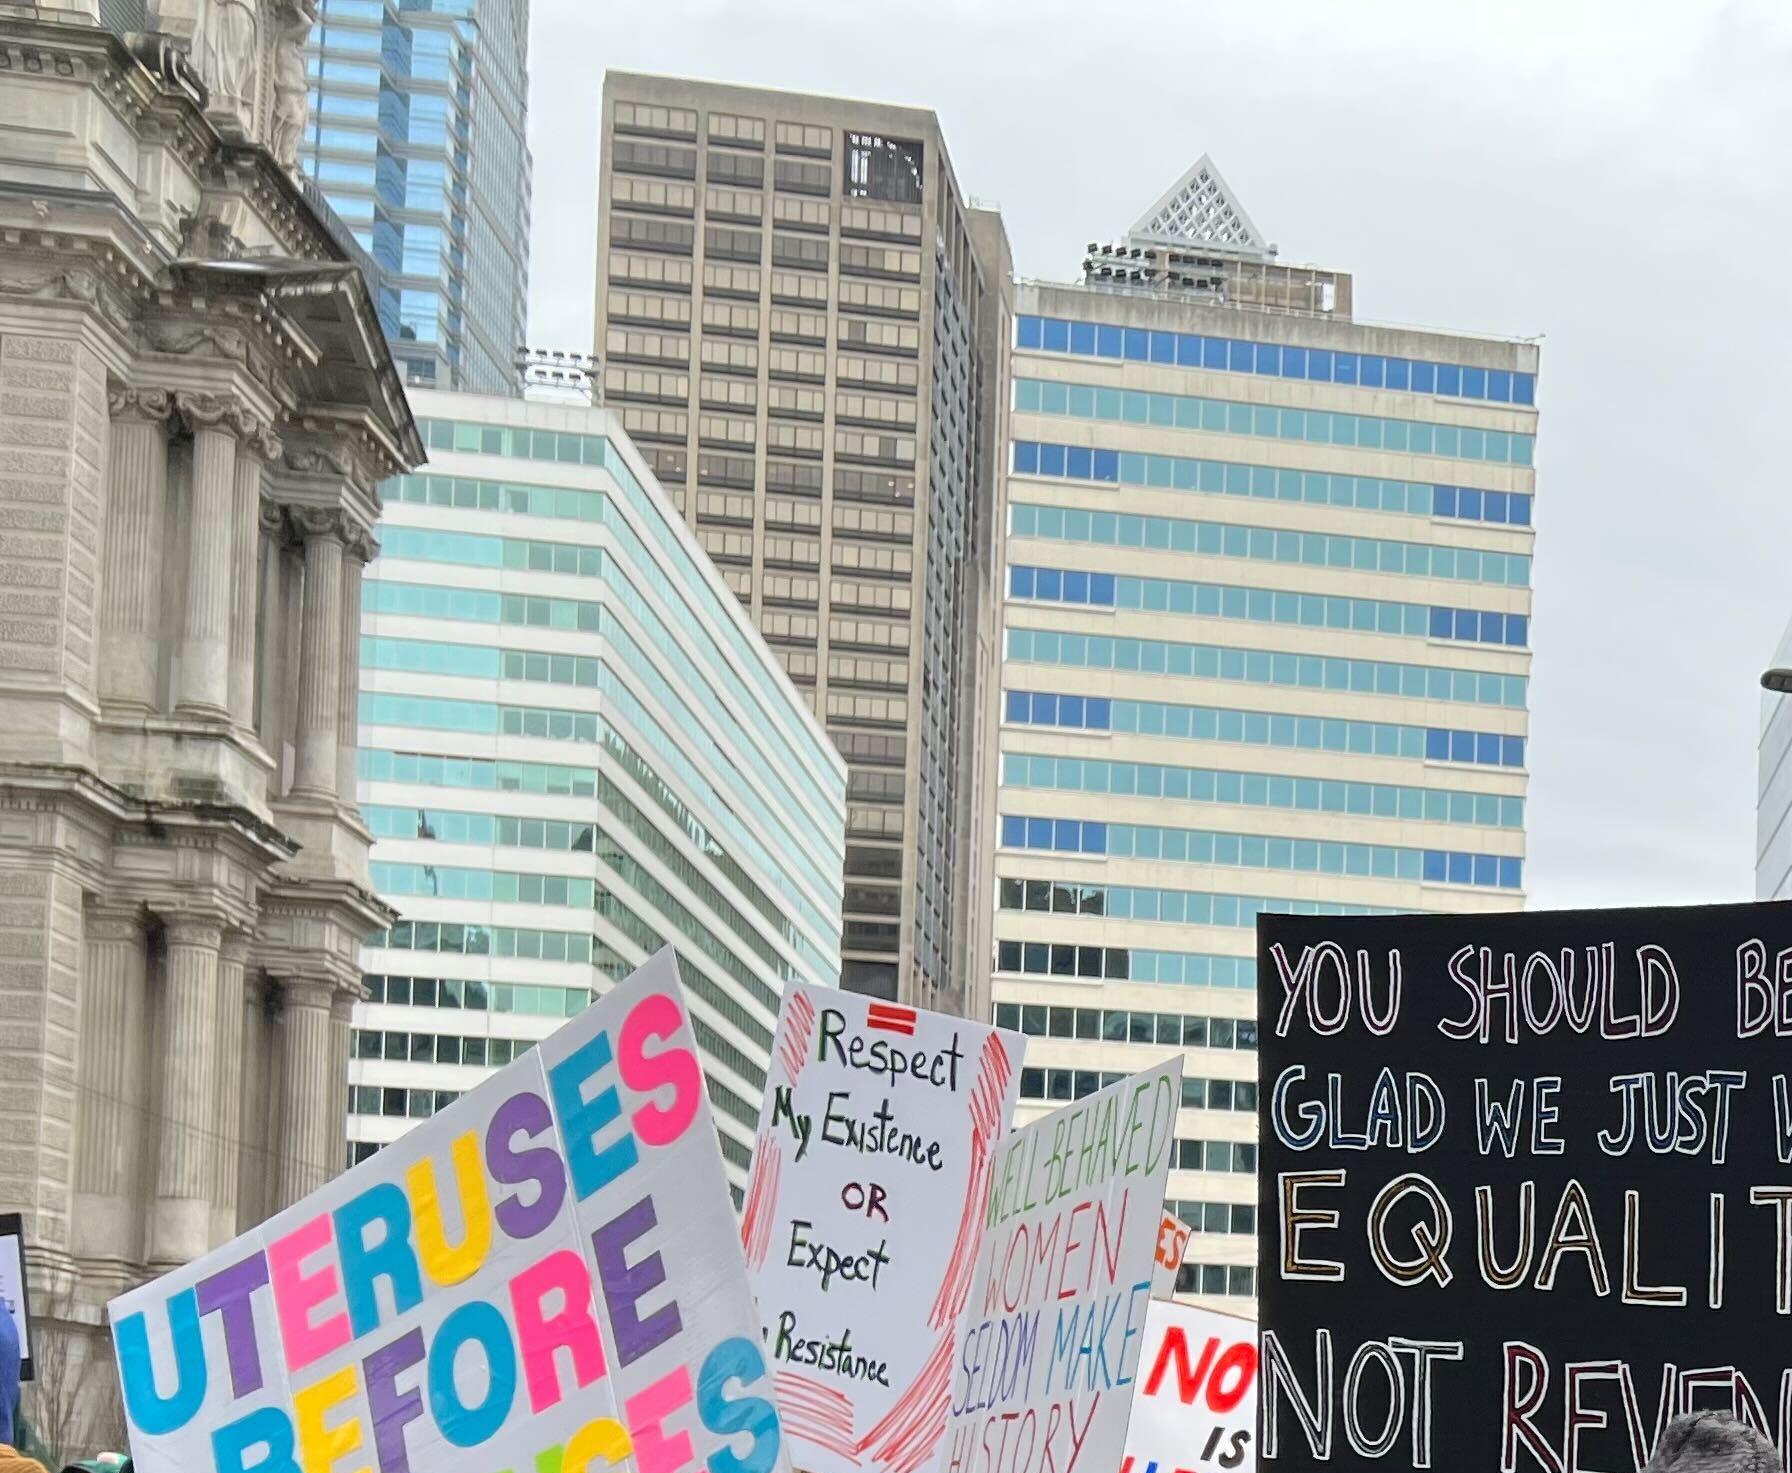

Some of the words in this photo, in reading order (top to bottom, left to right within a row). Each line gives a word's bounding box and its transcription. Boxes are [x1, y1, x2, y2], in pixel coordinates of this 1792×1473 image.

[1270, 940, 1401, 1038] YOU
[1437, 942, 1680, 1044] SHOULD
[817, 1008, 965, 1093] Respect
[772, 1085, 813, 1163] My
[820, 1090, 943, 1171] Existence
[1271, 1064, 1446, 1154] GLAD
[1474, 1075, 1565, 1158] WE
[1598, 1069, 1747, 1164] JUST
[114, 993, 702, 1436] UTERUSES
[840, 1181, 890, 1223] OR
[786, 1218, 891, 1292] Expect
[983, 1187, 1130, 1318] WOMEN
[774, 1310, 890, 1387] Resistance
[951, 1308, 1041, 1417] SELDOM
[1045, 1280, 1153, 1397] MAKE
[1142, 1325, 1259, 1414] NO
[1261, 1328, 1464, 1468] NOT
[1200, 1426, 1252, 1470] IS
